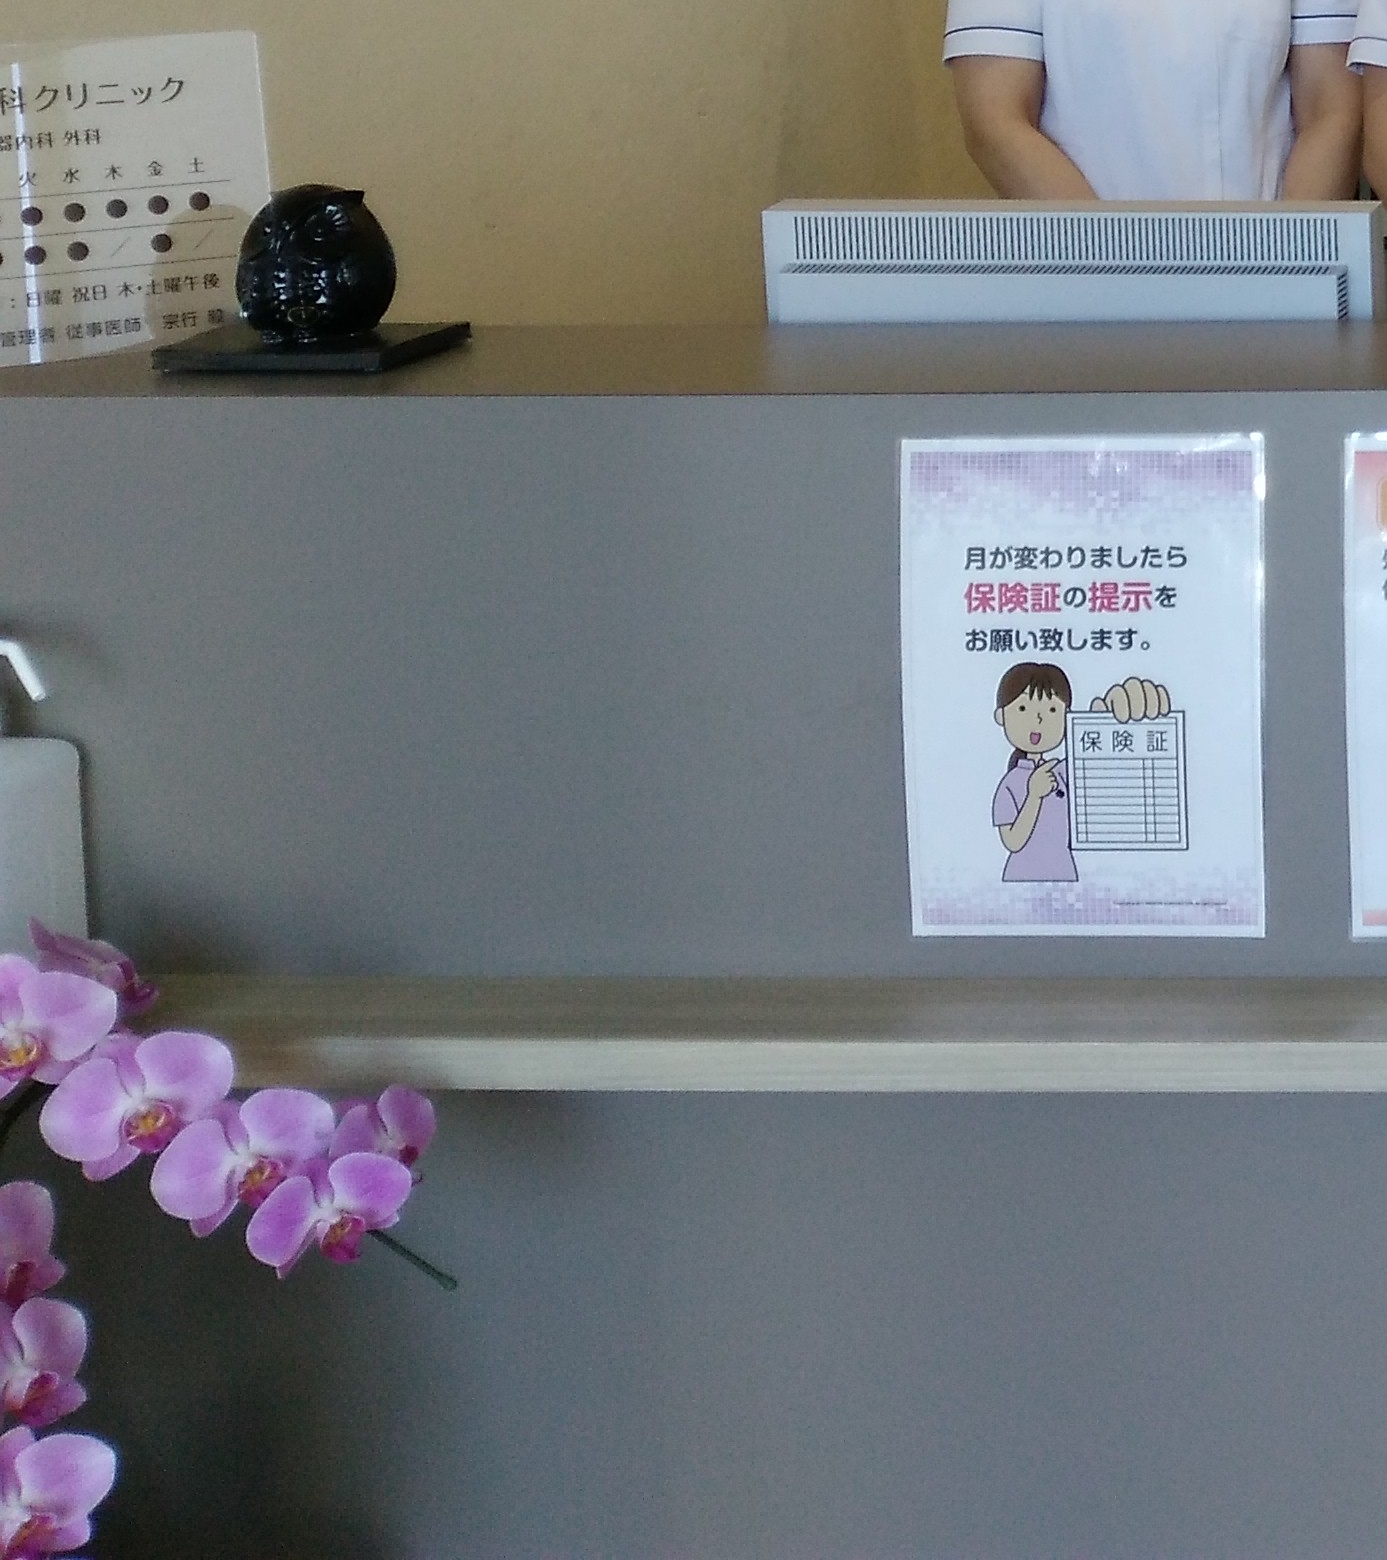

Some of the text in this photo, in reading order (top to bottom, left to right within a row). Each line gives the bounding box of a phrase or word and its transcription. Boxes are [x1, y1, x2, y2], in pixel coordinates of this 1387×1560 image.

[63, 127, 102, 148] 外科
[19, 156, 207, 188] 火 水 木 金 土
[72, 283, 108, 303] 祝日
[963, 544, 1189, 572] 月が変わりましたら
[963, 581, 1179, 616] 保険証の提示を
[963, 626, 1153, 654] お願い致します。
[1079, 729, 1170, 755] 保険証
